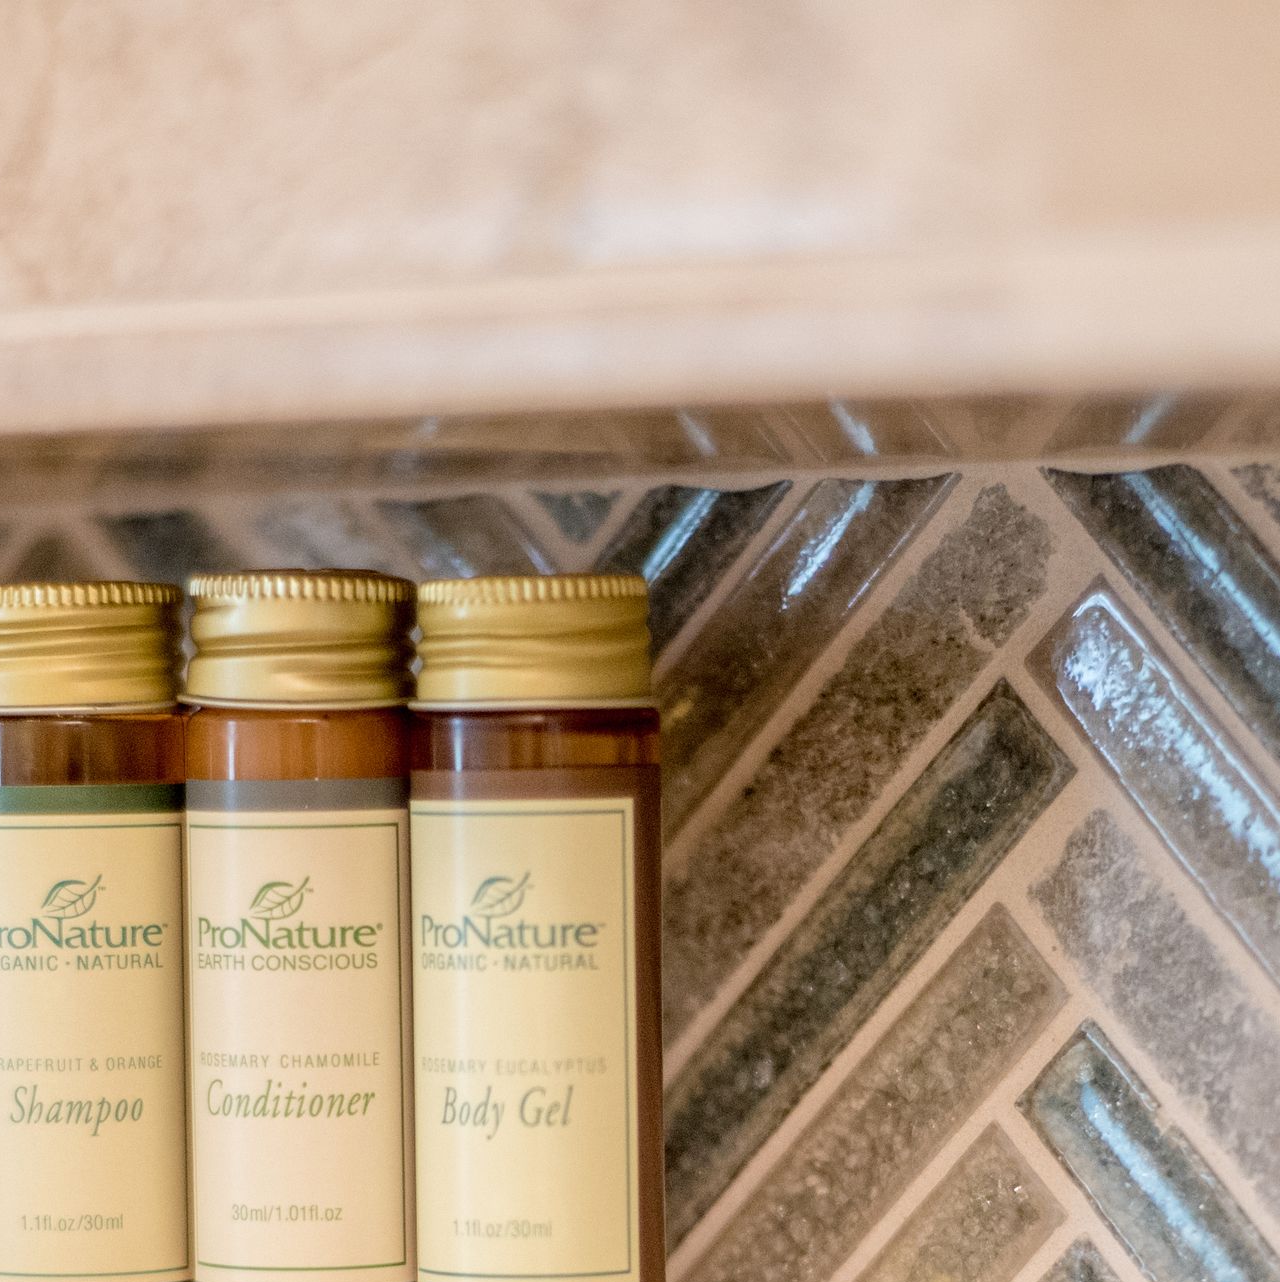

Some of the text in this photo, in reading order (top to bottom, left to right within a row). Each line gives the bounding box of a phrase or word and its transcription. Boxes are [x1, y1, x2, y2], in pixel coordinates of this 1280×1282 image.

[197, 917, 378, 950] ProNature
[421, 914, 599, 949] ProNature
[77, 952, 164, 970] NATURAL
[198, 952, 378, 971] EARTH CONSCIOUS
[421, 952, 599, 971] ORGANIC NATURAL
[89, 1056, 99, 1071] &
[106, 1055, 163, 1071] ORANGE
[200, 1051, 381, 1069] ROSEMARY CHAMOMILE
[421, 1056, 608, 1075] ROSEMARY EUCALYPTUS
[207, 1078, 376, 1118] Conditioner
[9, 1084, 144, 1137] Shampoo
[441, 1084, 575, 1140] Body Gel
